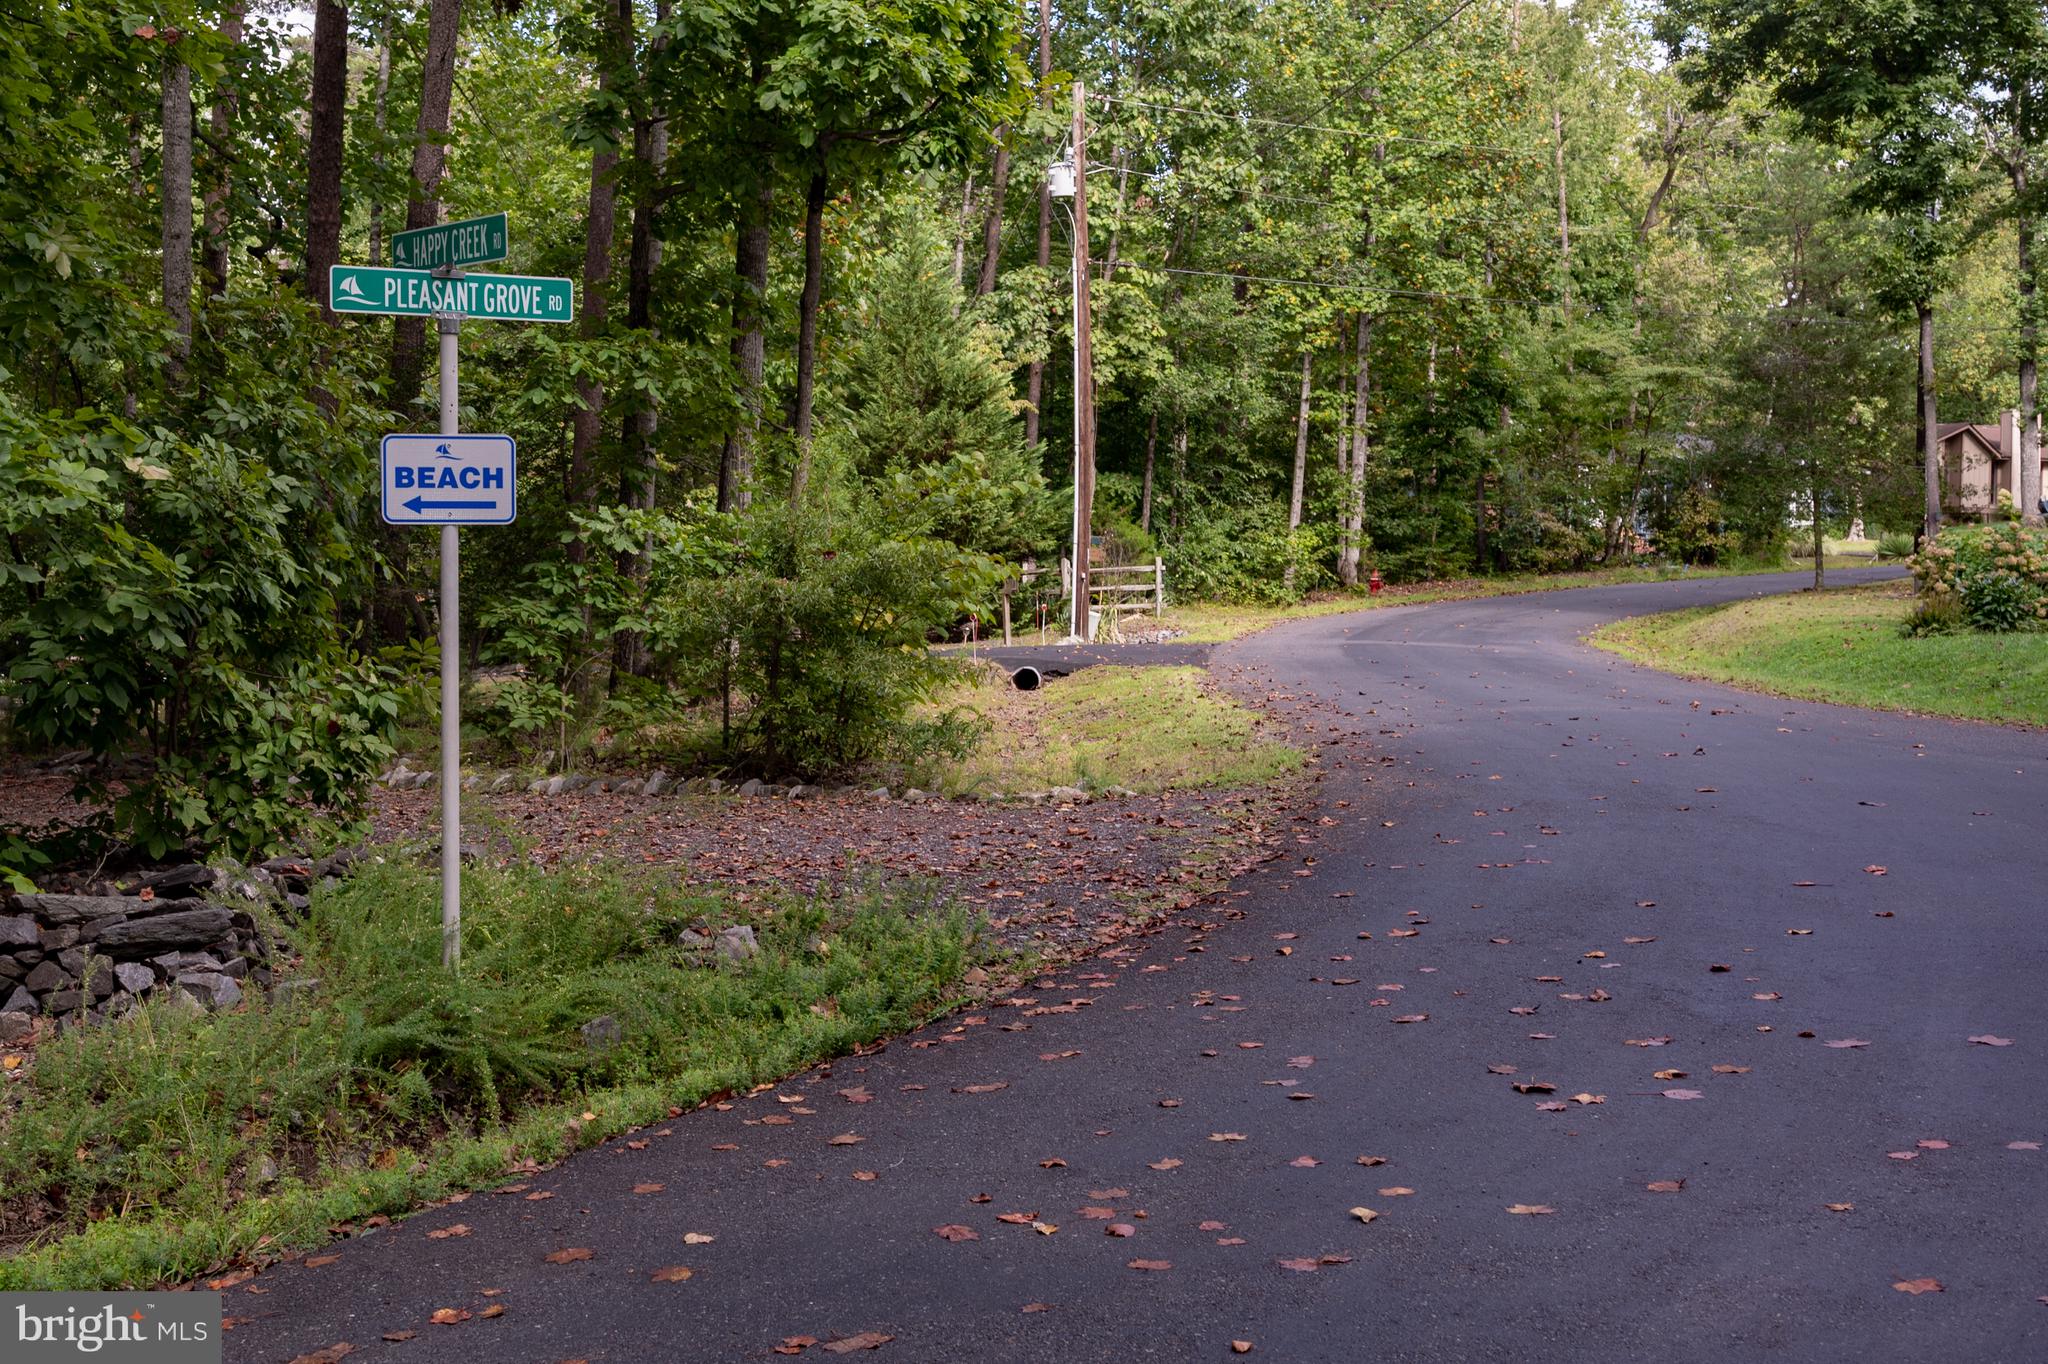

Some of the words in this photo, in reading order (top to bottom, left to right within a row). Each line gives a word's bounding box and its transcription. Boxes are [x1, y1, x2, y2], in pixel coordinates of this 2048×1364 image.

[413, 232, 448, 268] HAPPY
[452, 224, 488, 262] CREEK
[493, 232, 502, 250] RD
[385, 278, 478, 311] PLEASANT
[484, 283, 542, 315] GROVE
[549, 295, 562, 311] RD
[395, 467, 503, 489] BEACH
